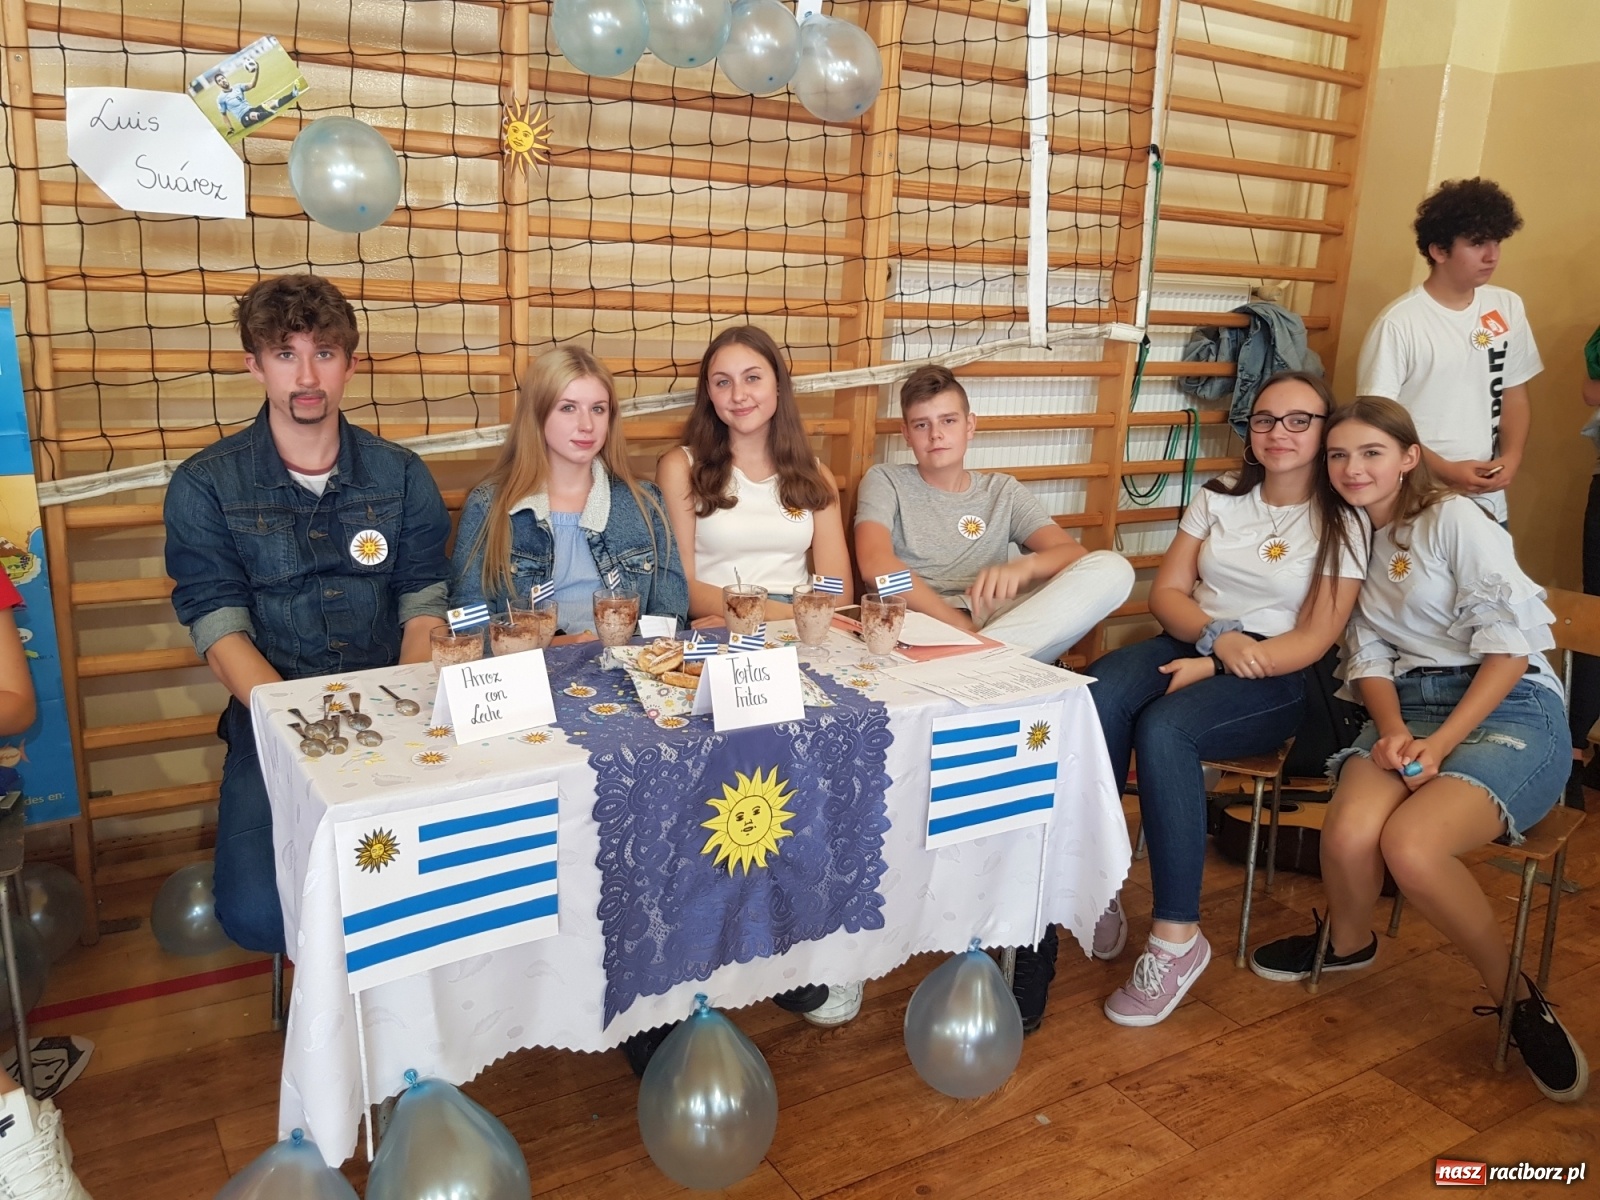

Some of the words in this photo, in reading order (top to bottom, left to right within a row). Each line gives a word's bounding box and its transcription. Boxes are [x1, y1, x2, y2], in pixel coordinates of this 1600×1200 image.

[90, 98, 160, 132] Luis
[135, 154, 228, 200] Suárez
[461, 666, 503, 689] Arroz
[726, 656, 771, 686] Tortas
[485, 690, 508, 703] con
[735, 686, 768, 708] Fritas
[470, 703, 503, 725] Leche
